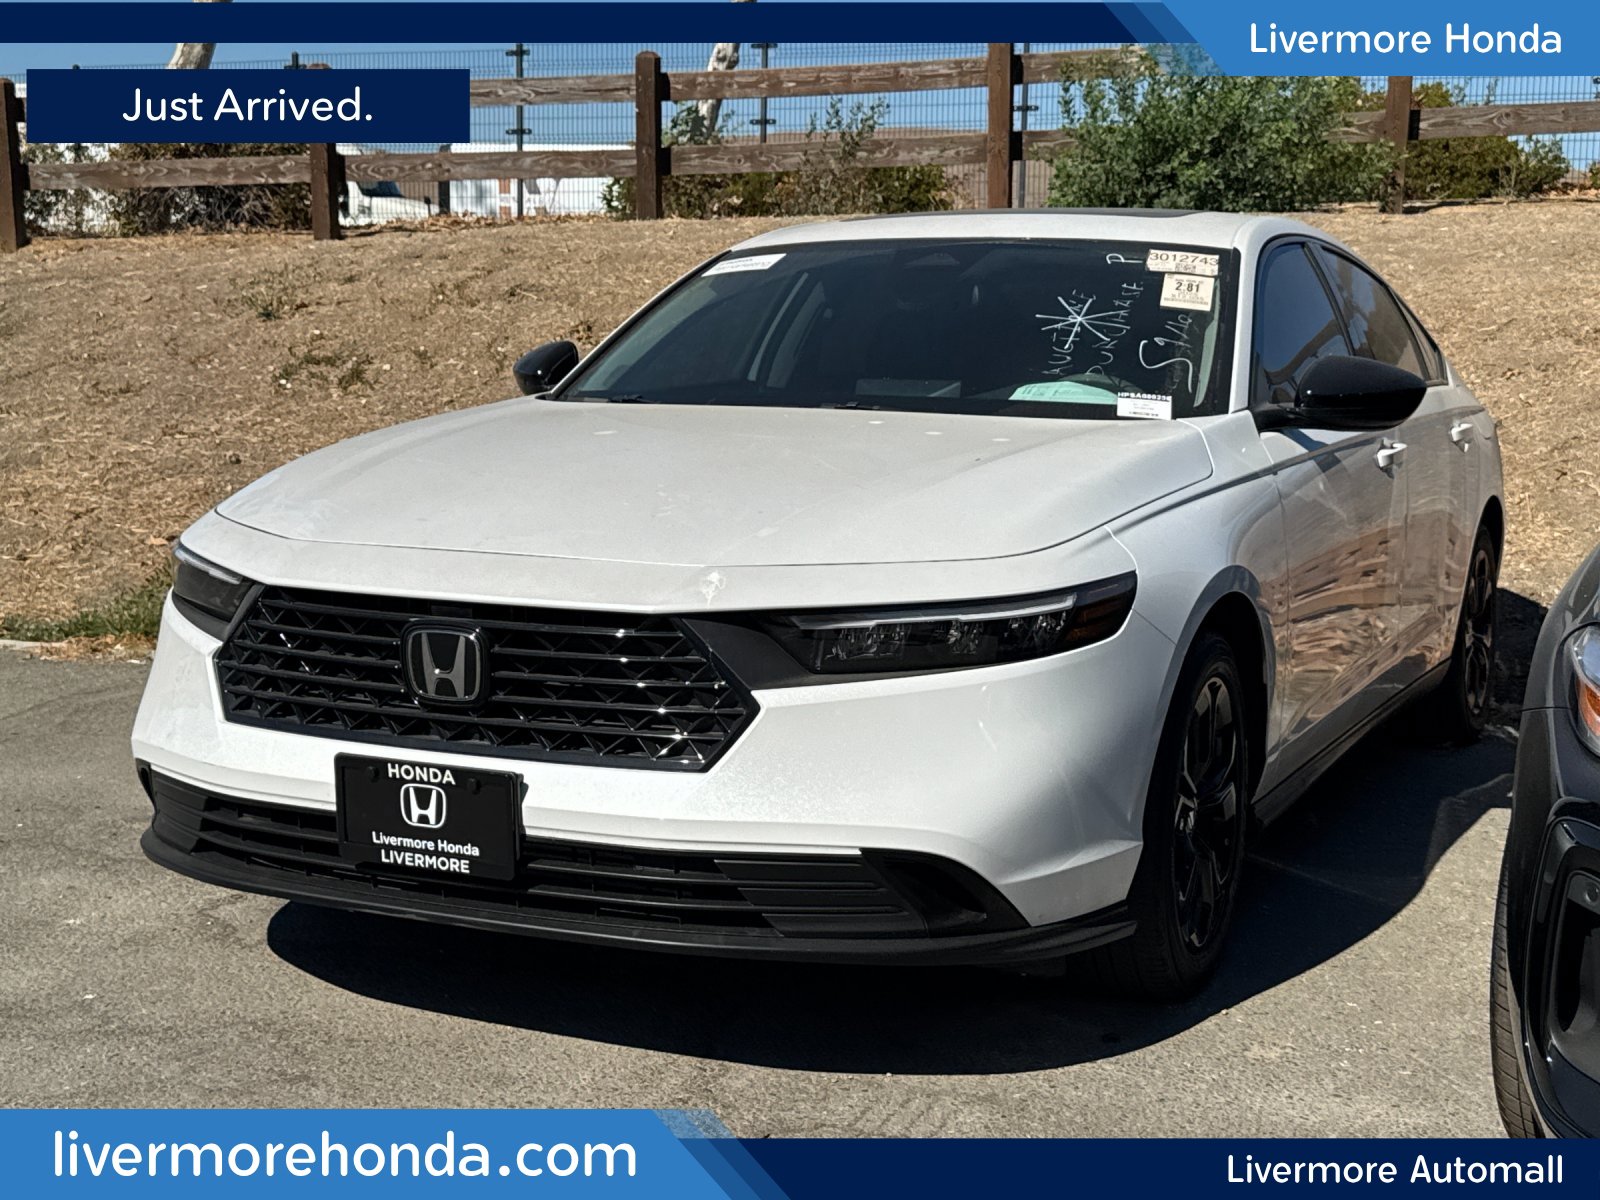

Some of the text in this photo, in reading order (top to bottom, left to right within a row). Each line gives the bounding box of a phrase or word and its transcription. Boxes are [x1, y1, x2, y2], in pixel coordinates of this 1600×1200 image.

[1149, 252, 1219, 266] 3012743
[387, 762, 456, 785] HONDA
[371, 830, 480, 857] Livermore Honda
[380, 849, 470, 874] LIVERMORE
